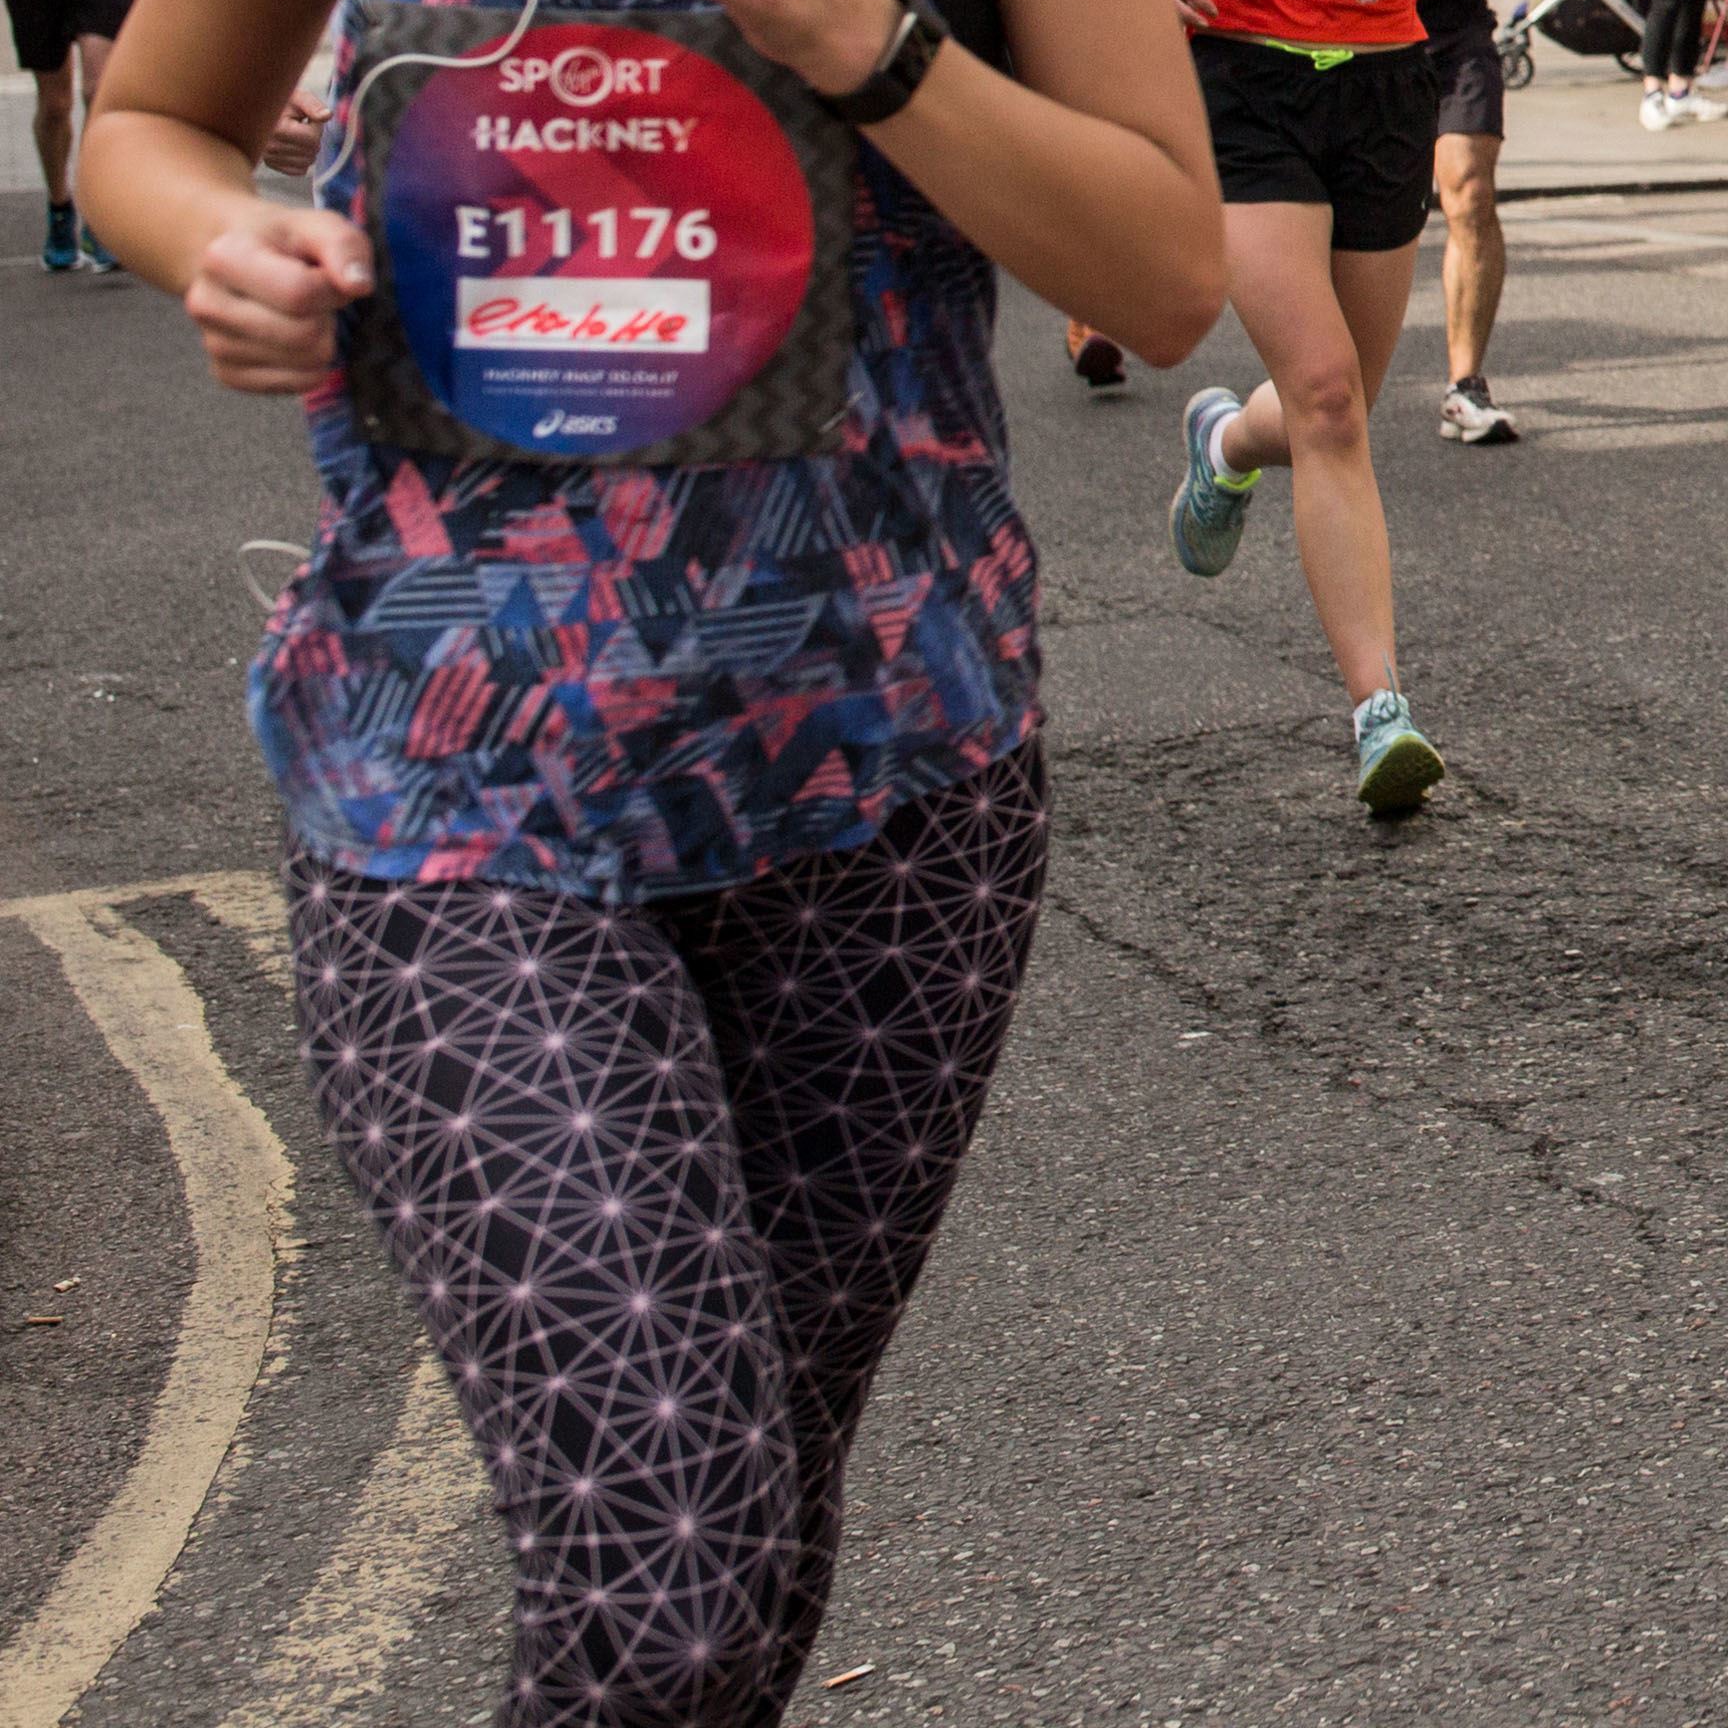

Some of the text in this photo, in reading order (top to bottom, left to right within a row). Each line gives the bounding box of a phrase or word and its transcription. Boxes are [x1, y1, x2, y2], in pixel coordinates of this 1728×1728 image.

[499, 47, 668, 107] SPORT
[472, 114, 698, 154] HACKNEY
[455, 204, 718, 262] E11176
